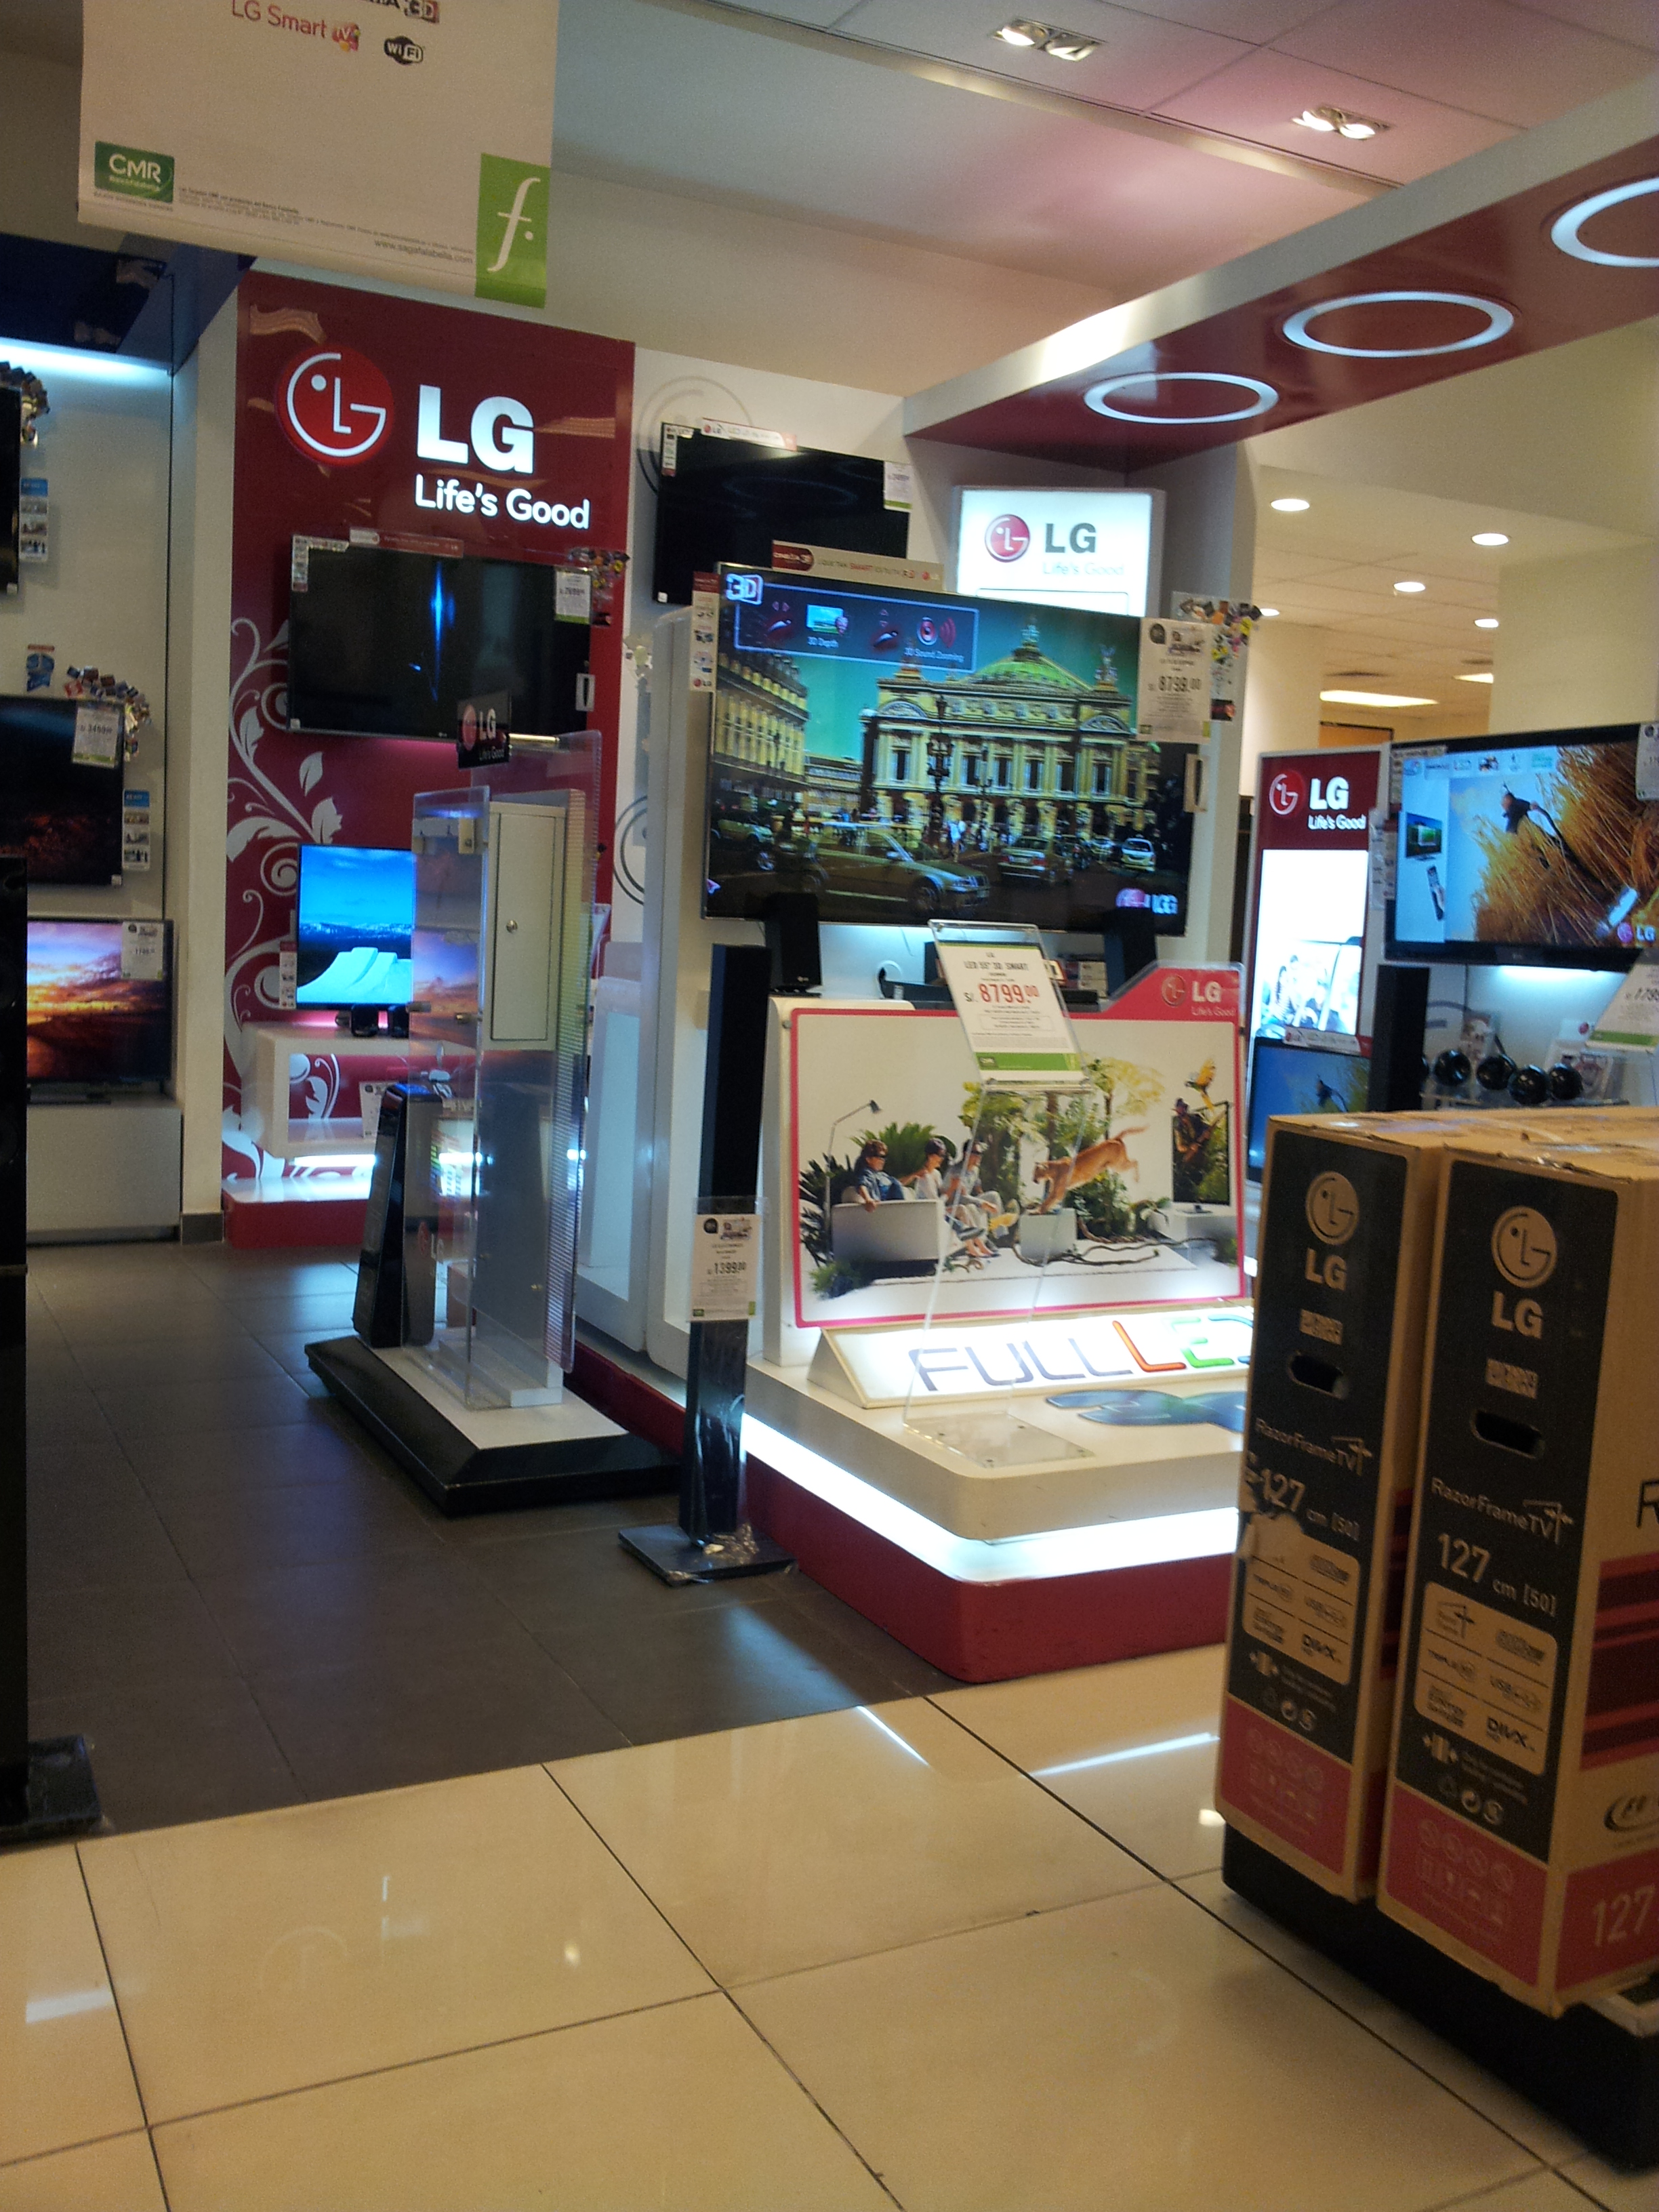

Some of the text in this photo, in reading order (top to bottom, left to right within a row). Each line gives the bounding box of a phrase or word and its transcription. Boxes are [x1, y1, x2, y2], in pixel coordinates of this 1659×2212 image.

[231, 0, 261, 21] LG
[266, 4, 328, 39] Smart
[108, 153, 162, 183] CMR
[416, 384, 535, 474] LG
[415, 473, 591, 530] Life's Good
[1044, 522, 1097, 554] LG
[1084, 561, 1125, 575] Good
[725, 573, 758, 601] 3D
[479, 707, 497, 741] LG
[1309, 776, 1350, 811] LG
[1307, 813, 1367, 830] Life's Good
[1636, 924, 1656, 943] LG
[1191, 980, 1222, 1004] LG
[1305, 1248, 1348, 1291] LG
[1492, 1290, 1544, 1339] LG
[1261, 1467, 1305, 1512] 127
[1305, 1509, 1329, 1526] cm
[1437, 1532, 1490, 1582] 127
[1492, 1578, 1517, 1599] cm
[1592, 1883, 1656, 1947] 127
